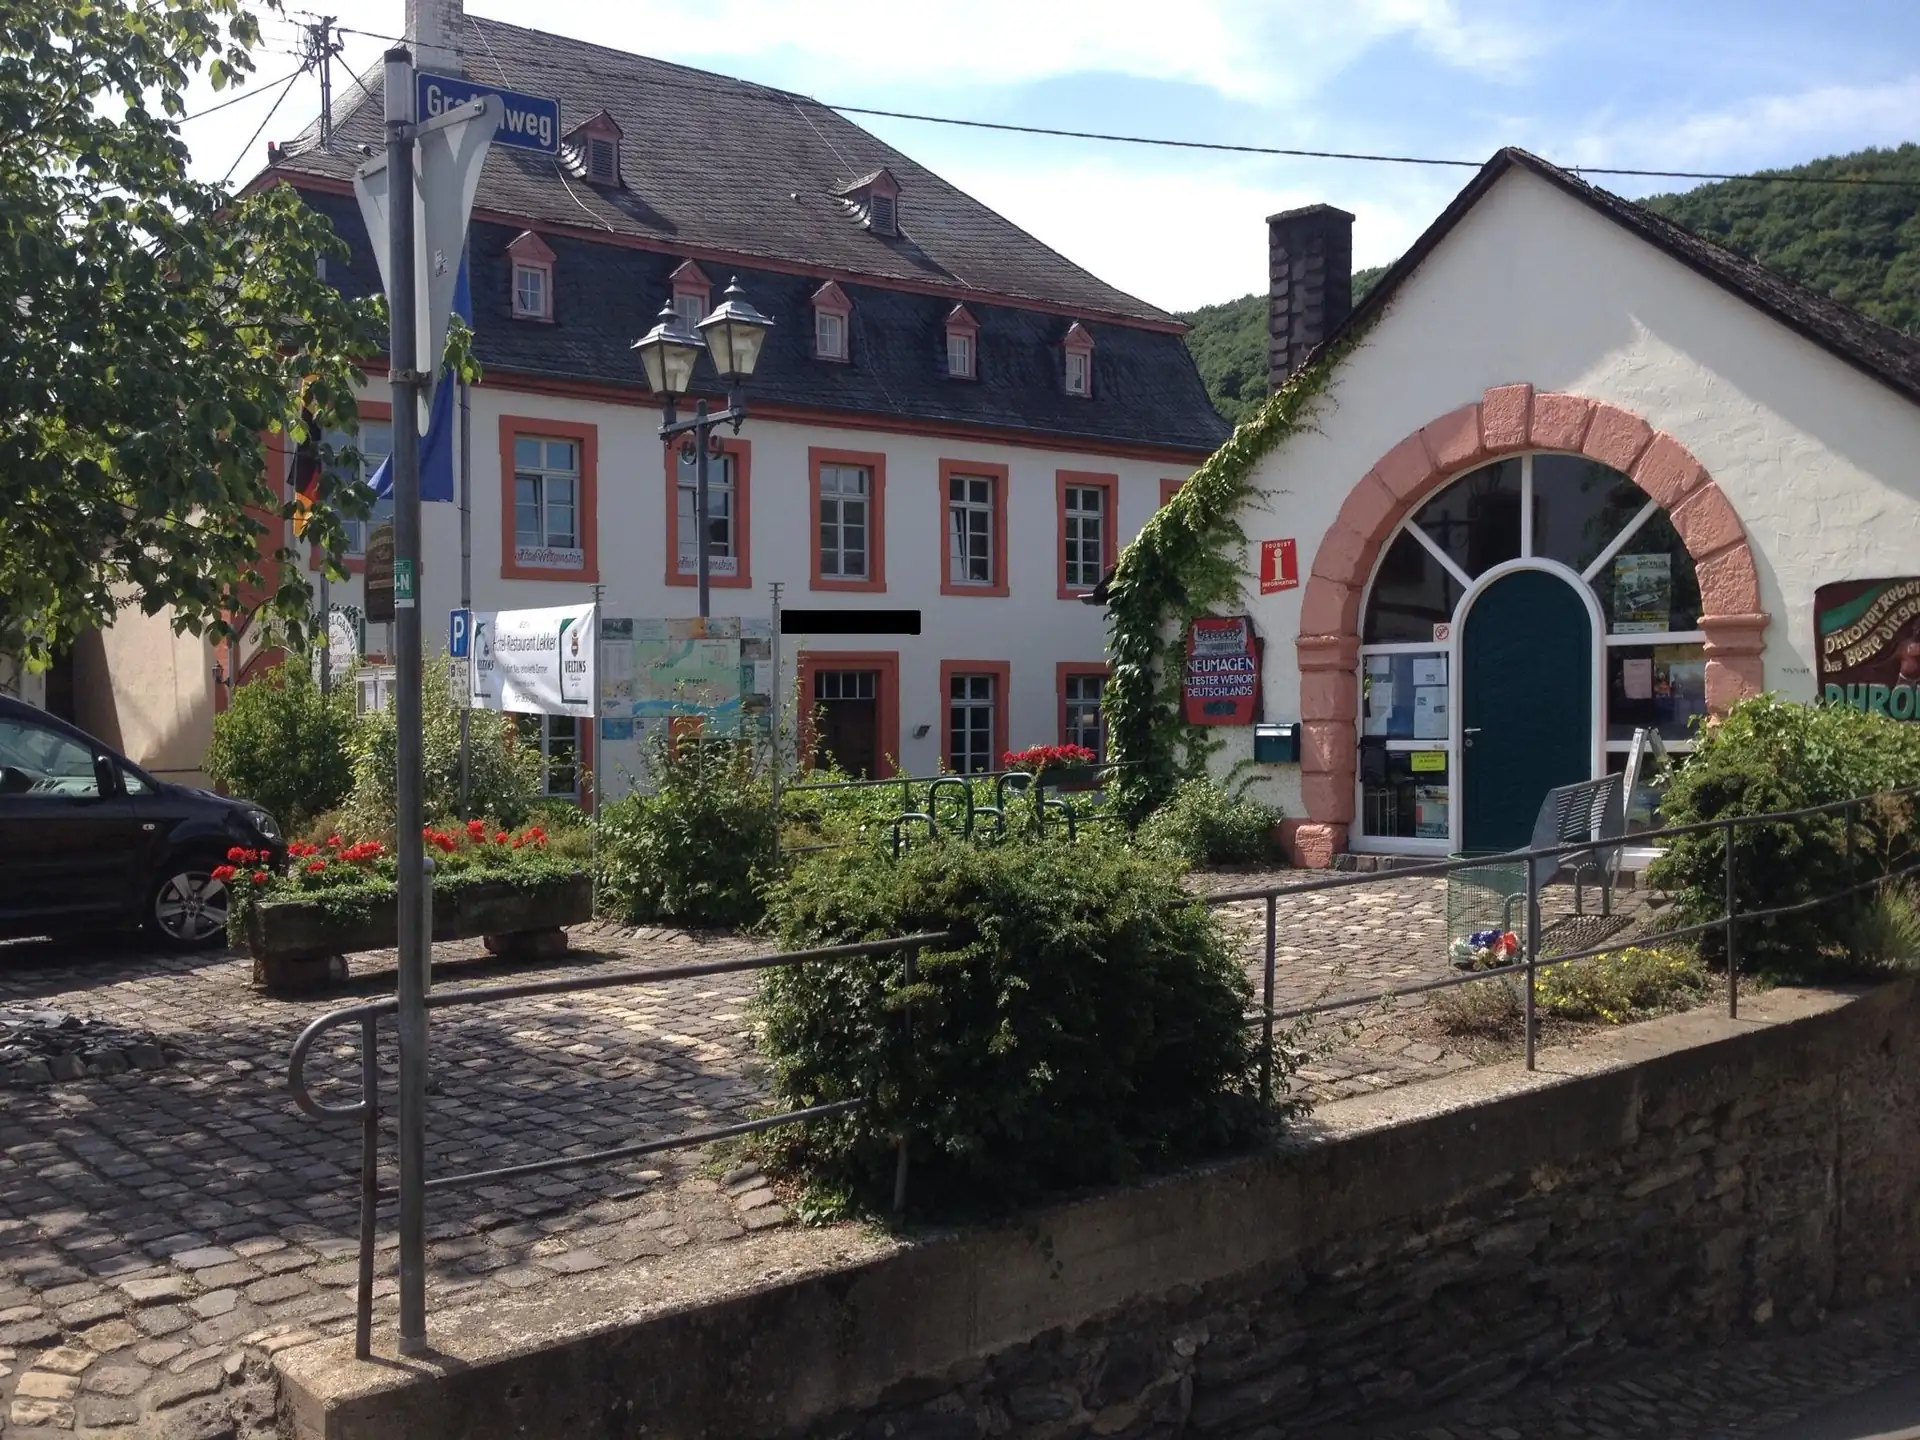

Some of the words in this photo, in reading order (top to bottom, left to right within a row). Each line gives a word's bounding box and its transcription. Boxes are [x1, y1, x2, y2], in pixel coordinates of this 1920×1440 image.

[1265, 541, 1291, 549] TOURIST
[1262, 580, 1297, 588] INFORMATION
[453, 615, 465, 652] P
[564, 659, 587, 673] VELTINS
[1186, 657, 1256, 674] NEUMAGEN
[1220, 673, 1257, 685] WEINORT
[1188, 686, 1253, 698] DEUTSCHLANDS
[1825, 683, 1920, 719] DHRO
